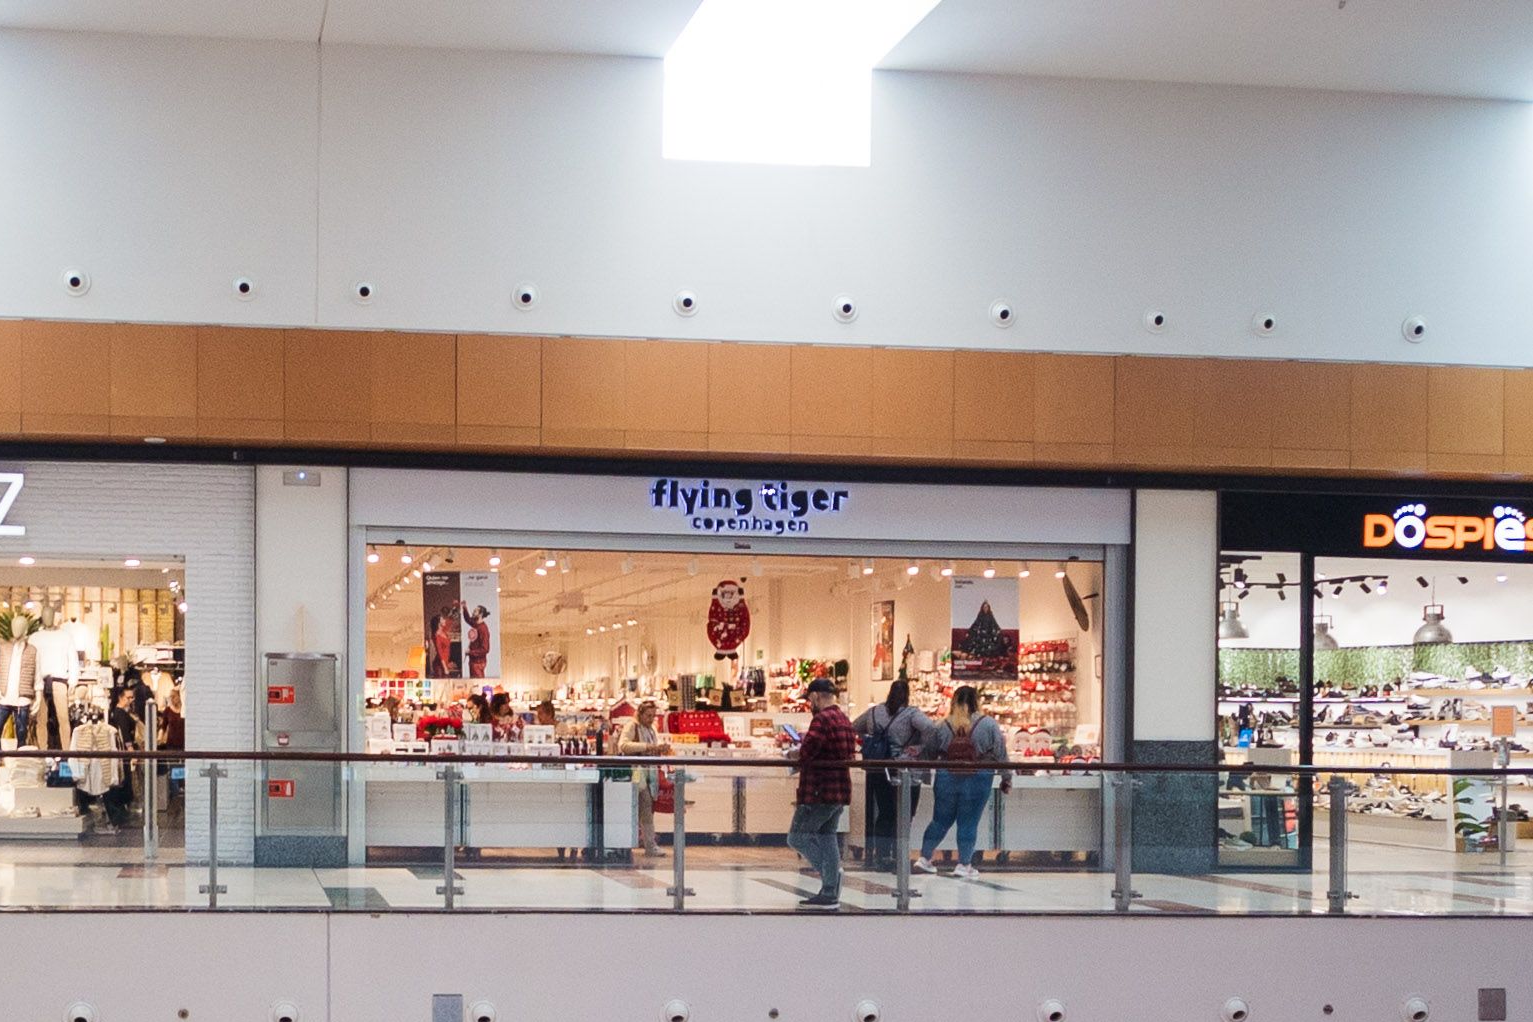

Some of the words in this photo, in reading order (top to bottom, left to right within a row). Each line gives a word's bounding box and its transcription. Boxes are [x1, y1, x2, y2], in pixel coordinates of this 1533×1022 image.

[651, 478, 753, 516] flying
[760, 481, 849, 517] tiger
[692, 515, 809, 535] copenhagen
